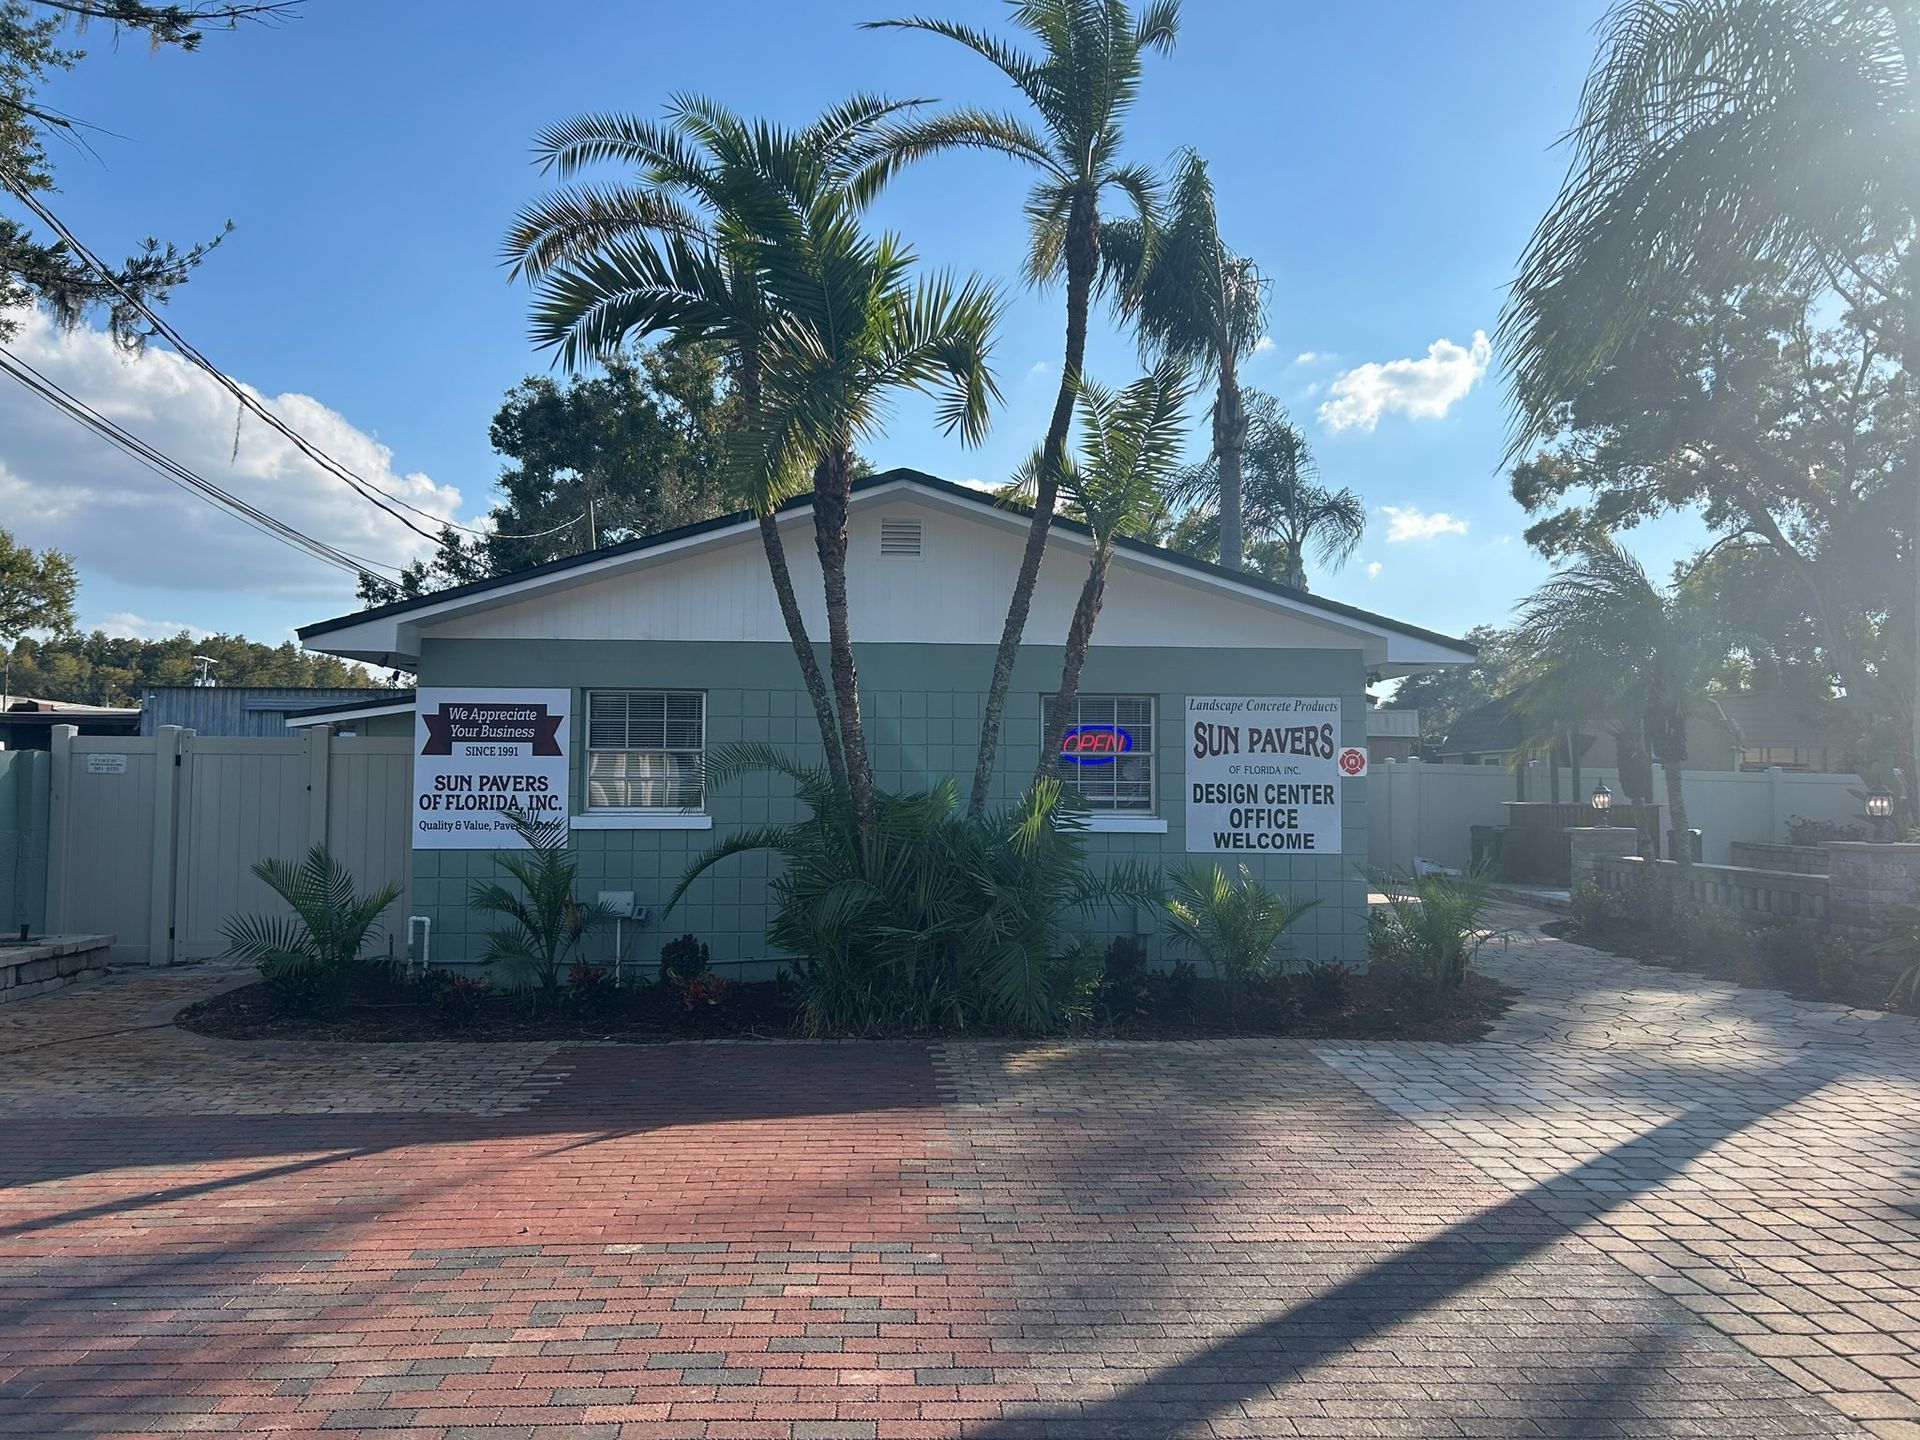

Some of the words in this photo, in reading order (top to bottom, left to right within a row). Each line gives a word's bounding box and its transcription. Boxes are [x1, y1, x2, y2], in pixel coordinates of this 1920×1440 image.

[1189, 699, 1243, 714] Landscape
[1246, 699, 1291, 712] Concrete
[1293, 700, 1338, 712] Products
[449, 707, 467, 721] We
[469, 708, 538, 724] Appreciate
[450, 724, 479, 738] Your
[480, 725, 535, 738] Business
[1062, 734, 1124, 752] OPEN
[1193, 721, 1240, 759] SUN
[1248, 723, 1334, 760] PAVERS
[465, 746, 495, 756] SINCE
[498, 746, 519, 757] 1991
[1228, 765, 1241, 775] OF
[1244, 765, 1281, 775] FLORIDA
[1284, 766, 1301, 775] INC.
[434, 775, 472, 792] SUN
[479, 775, 549, 792] PAVERS
[1192, 783, 1258, 804] DESIGN
[1264, 784, 1335, 805] CENTER
[419, 794, 442, 810] OF
[445, 794, 524, 813] FLORIDA,
[528, 795, 562, 811] INC.
[419, 820, 454, 832] Quality
[455, 820, 462, 830] &
[464, 820, 492, 832] Value,
[494, 820, 523, 830] Pave
[1229, 808, 1298, 829] OFFICE
[1213, 832, 1315, 850] WELCOME
